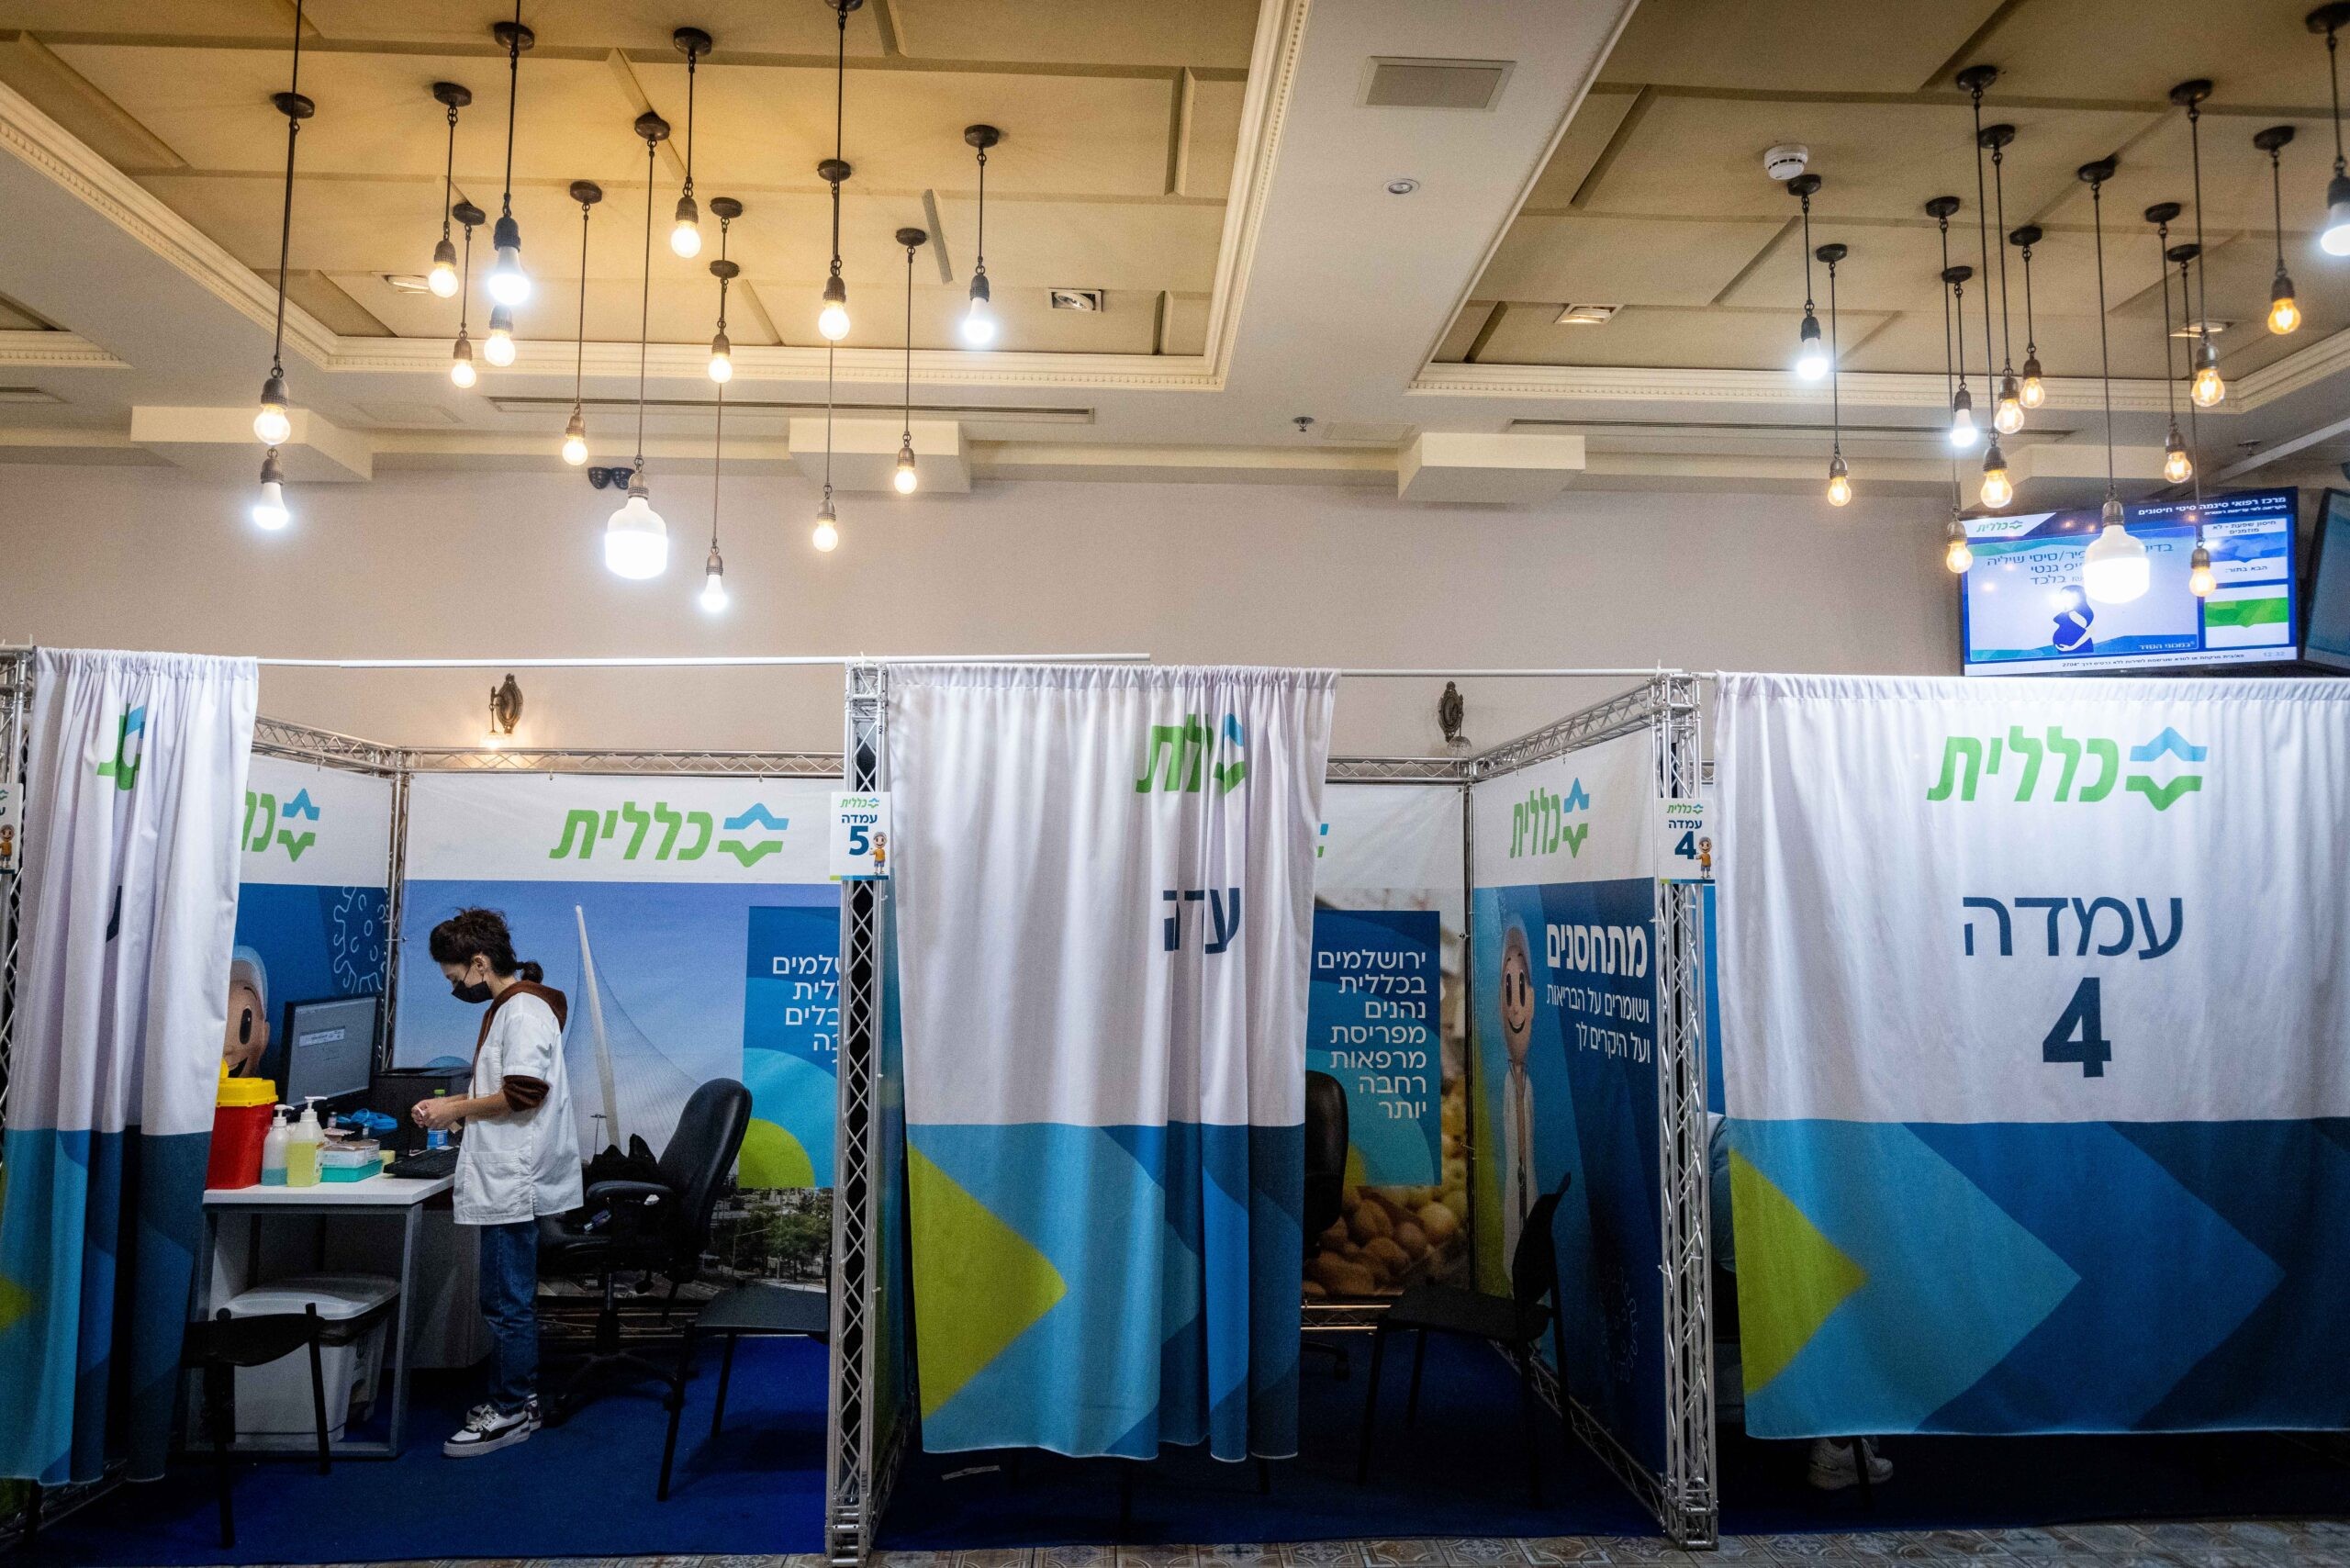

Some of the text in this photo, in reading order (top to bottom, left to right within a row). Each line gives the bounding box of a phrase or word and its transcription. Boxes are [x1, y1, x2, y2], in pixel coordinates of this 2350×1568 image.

[2138, 496, 2287, 516] מרכז רפואי סינמה סיטי חיסונים
[1976, 522, 2008, 532] כללית
[1986, 549, 2086, 566] פיר/סיסי שיליה
[2031, 564, 2059, 574] גנטי
[1927, 725, 2120, 801] כללית
[840, 797, 867, 808] כללית
[1667, 803, 1692, 814] כללית
[842, 814, 878, 823] עמדה
[1509, 787, 1561, 858] כללית
[1668, 819, 1703, 829] עמדה
[549, 801, 713, 860] כללית
[848, 825, 869, 856] 5
[1674, 831, 1696, 860] 4
[1963, 896, 2184, 960] עמדה
[1318, 948, 1427, 969] ירושלמים
[1546, 923, 1648, 979] מתחסנים
[1338, 974, 1427, 994] בכללית
[1365, 1001, 1427, 1019] נהנים
[1546, 983, 1650, 1024] ושומרים על הבריאות
[1330, 1025, 1427, 1044] מפריסת
[2042, 977, 2112, 1078] 4
[1575, 1021, 1651, 1064] ועל היקרים לך
[1329, 1050, 1427, 1069] מרפאות
[1359, 1076, 1427, 1094] רחבה
[1378, 1101, 1427, 1119] יותר
